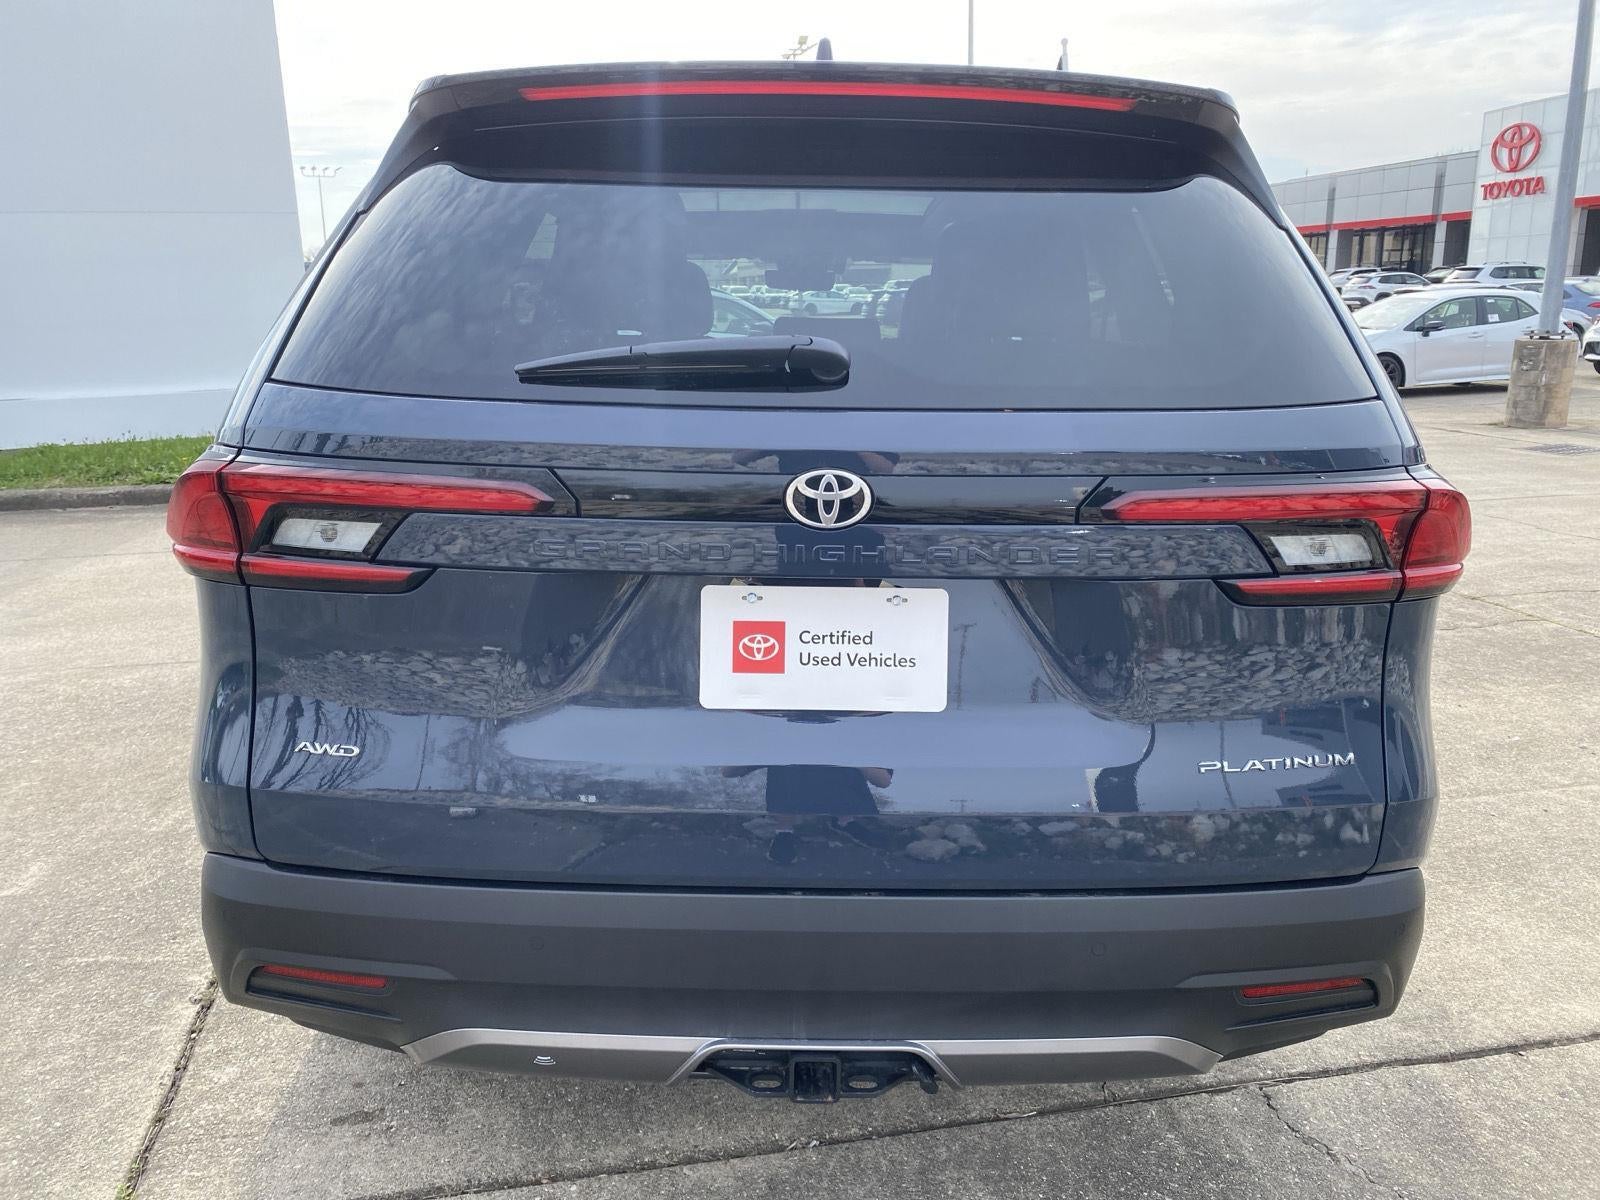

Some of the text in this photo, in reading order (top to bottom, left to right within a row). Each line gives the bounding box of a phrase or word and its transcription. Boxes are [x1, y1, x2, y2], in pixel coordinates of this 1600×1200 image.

[1482, 176, 1545, 200] TOYOTA
[533, 537, 1122, 567] GRAND HIGHLANDER
[798, 629, 874, 647] Certified
[799, 651, 917, 669] Used Vehicles
[294, 741, 360, 757] AWD
[1198, 752, 1355, 773] PLATINUM
